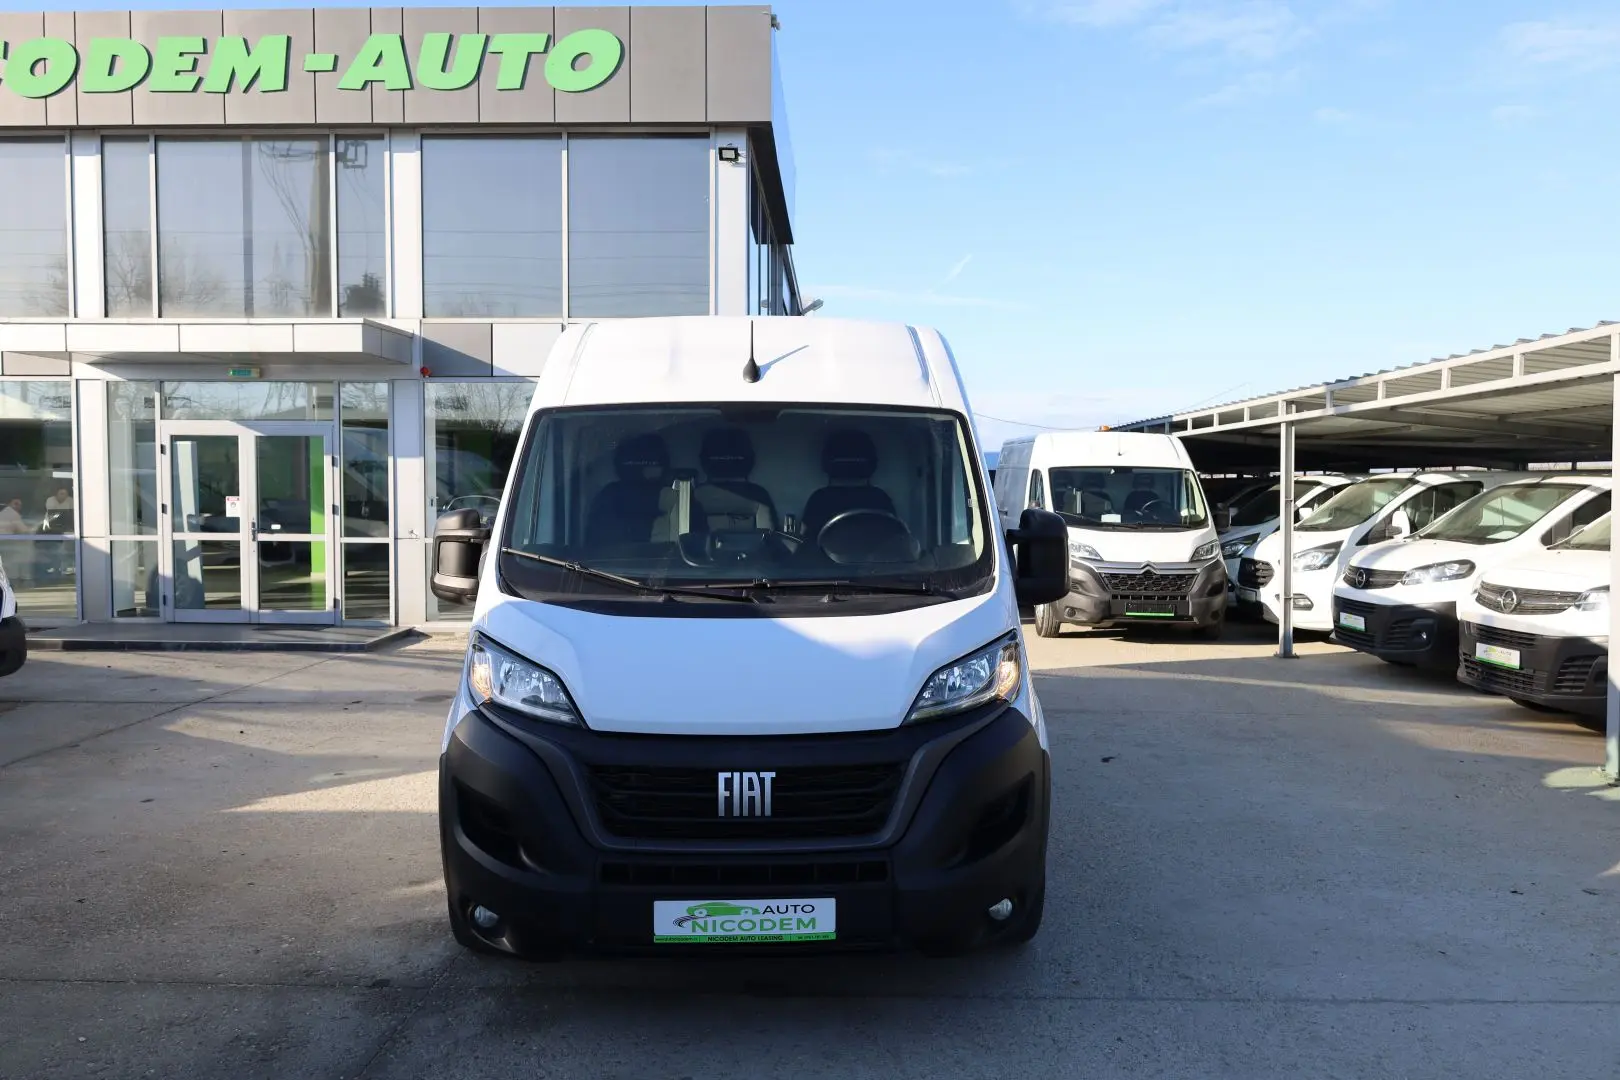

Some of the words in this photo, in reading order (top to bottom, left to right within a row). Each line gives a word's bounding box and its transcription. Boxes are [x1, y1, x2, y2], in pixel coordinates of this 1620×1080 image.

[0, 28, 625, 98] ODEM-AUTO
[718, 771, 776, 817] FIAT
[691, 917, 816, 933] NICODEM
[762, 904, 815, 915] AUTO
